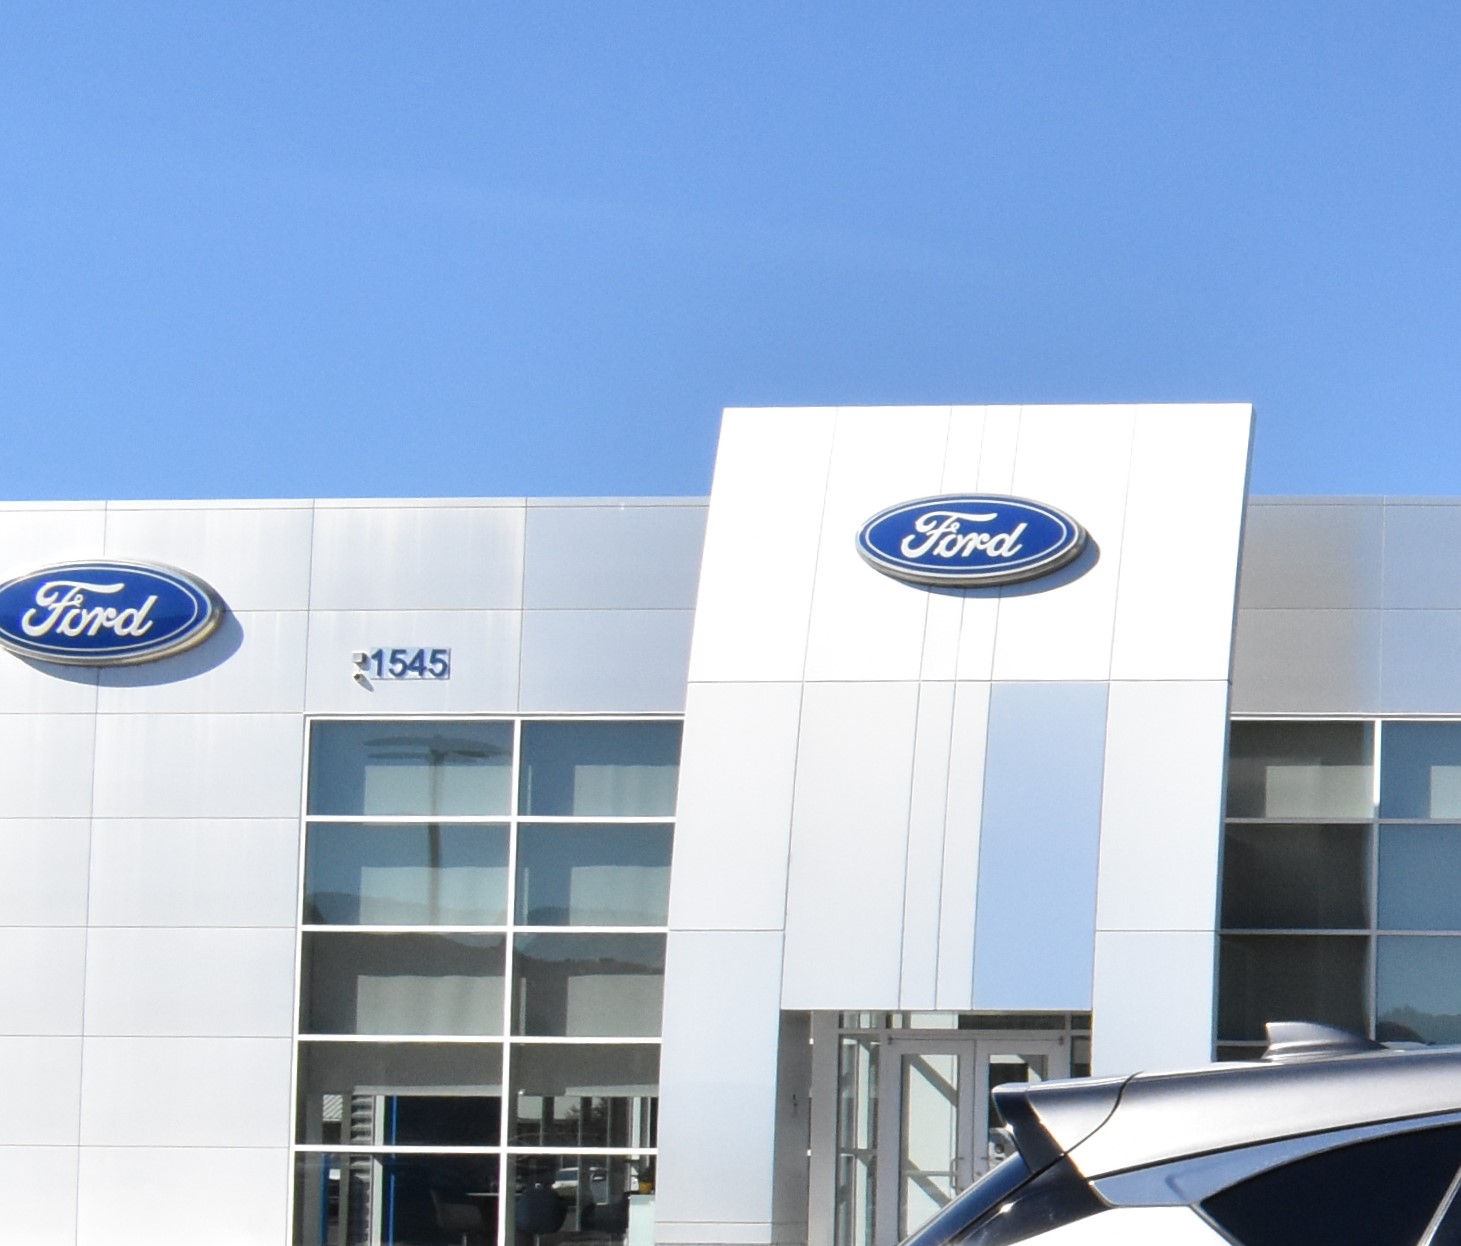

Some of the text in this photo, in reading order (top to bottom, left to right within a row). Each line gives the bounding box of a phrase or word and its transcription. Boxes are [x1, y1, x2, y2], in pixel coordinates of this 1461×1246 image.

[901, 510, 1028, 559] Ford
[21, 580, 159, 637] Ford
[371, 648, 448, 678] 1545
